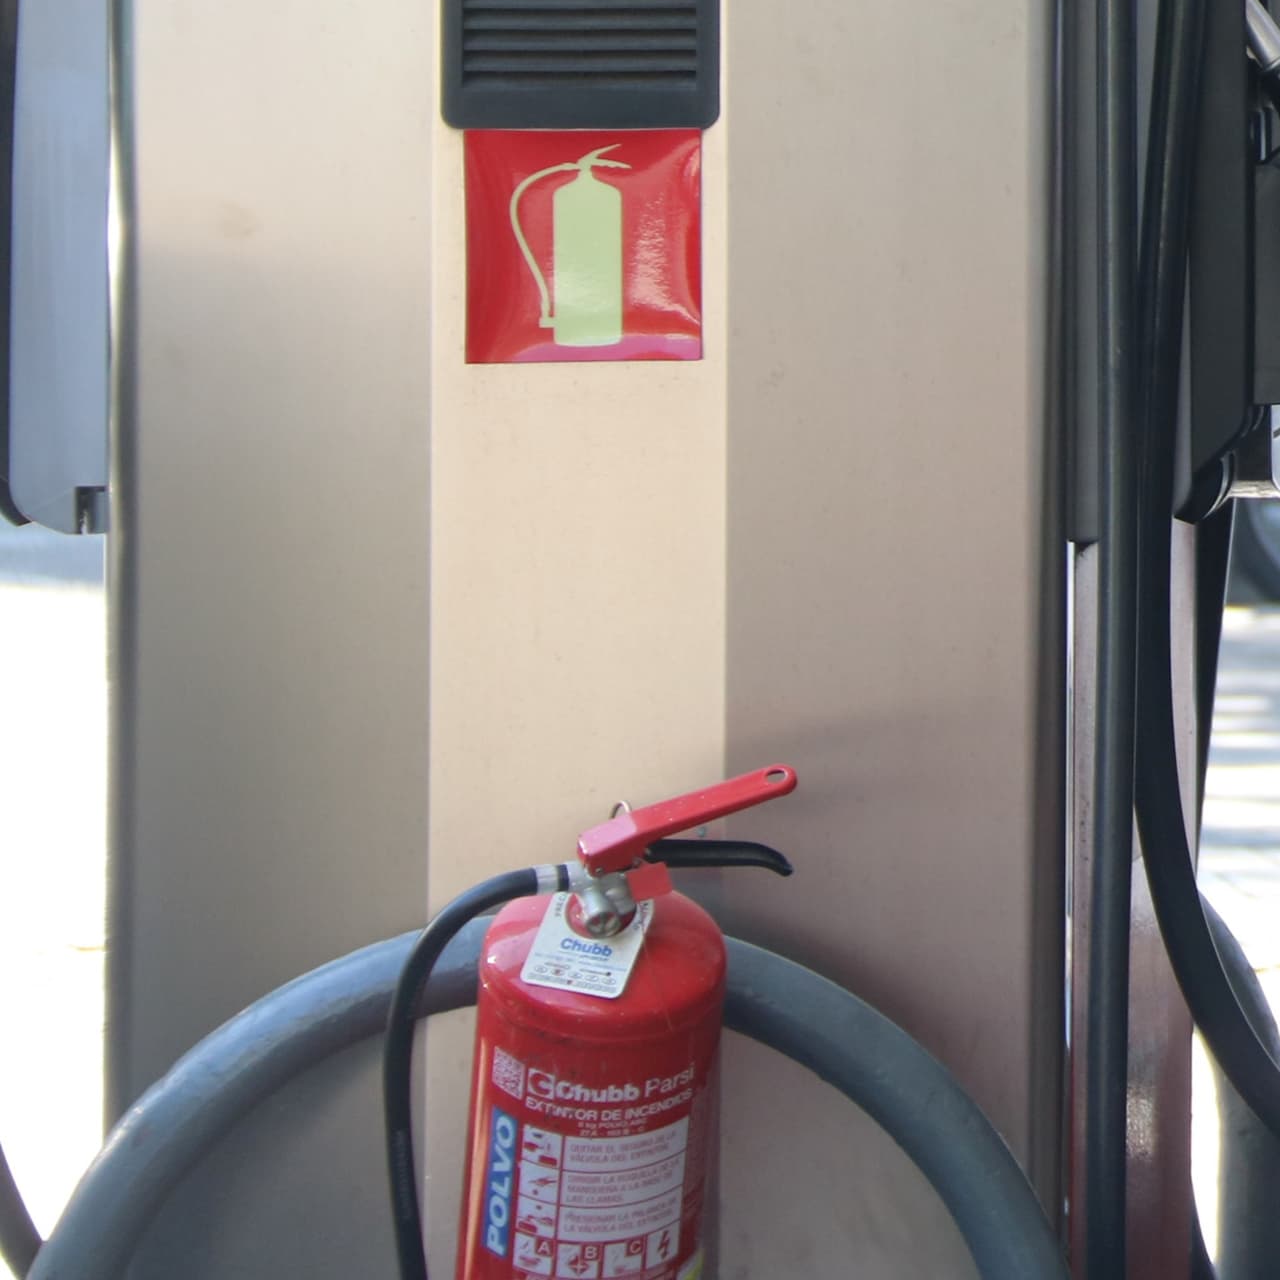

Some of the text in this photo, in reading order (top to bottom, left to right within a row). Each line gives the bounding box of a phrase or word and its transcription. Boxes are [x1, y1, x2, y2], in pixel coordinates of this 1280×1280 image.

[560, 938, 613, 957] Chubb
[556, 1081, 640, 1102] Chubb
[602, 1110, 621, 1121] DE
[486, 1115, 514, 1257] POLVO
[538, 1241, 550, 1254] A
[584, 1245, 597, 1259] B
[629, 1240, 642, 1254] C
